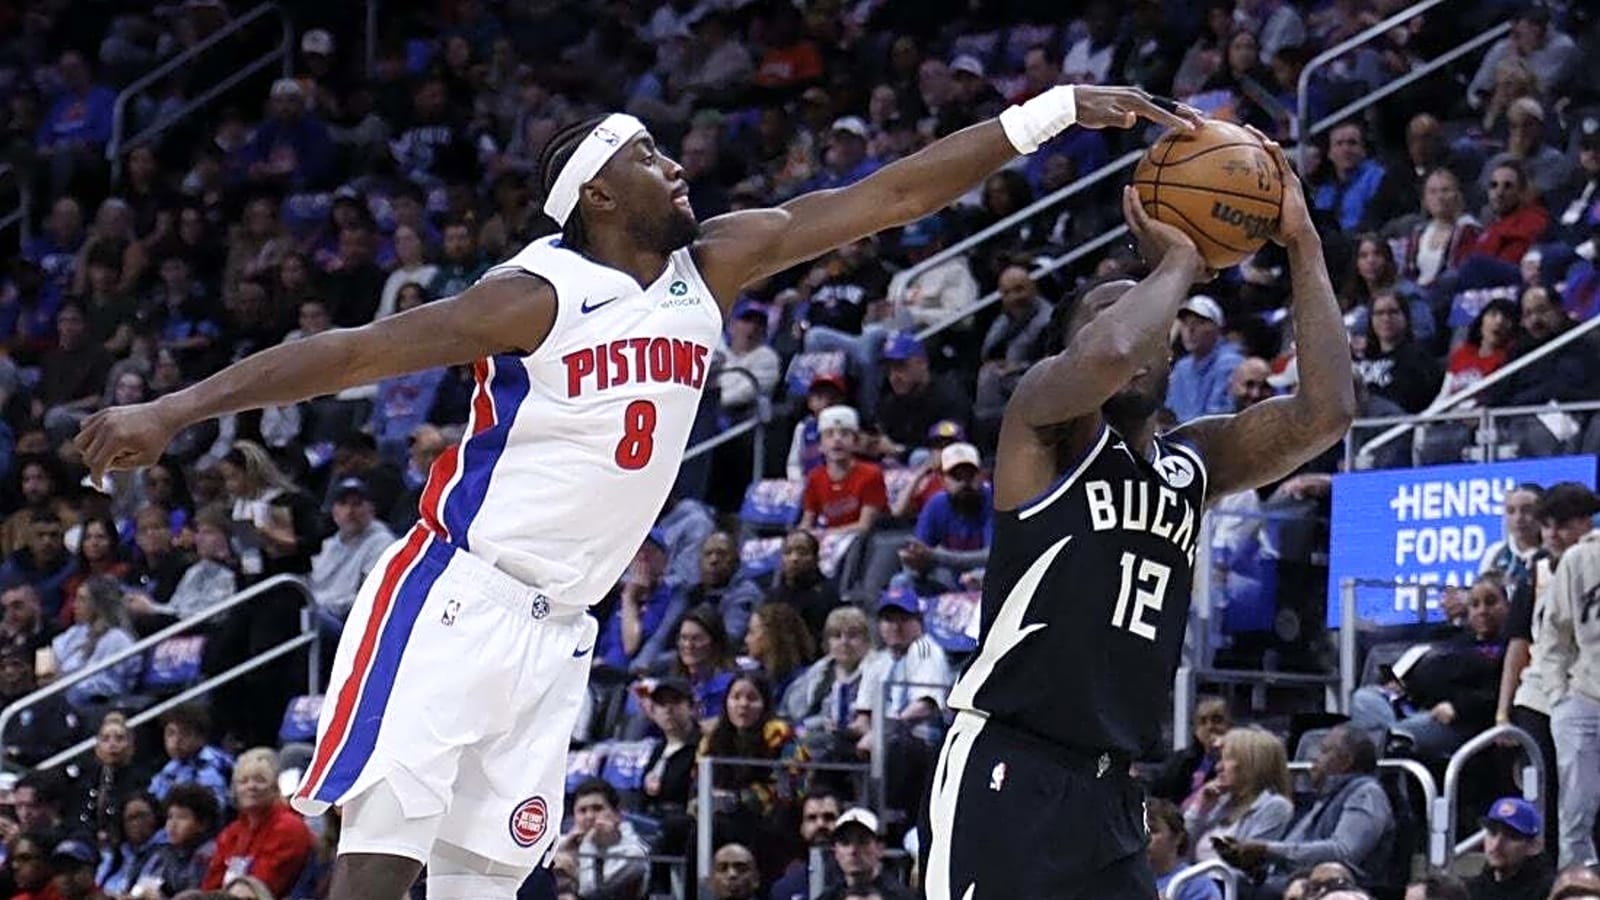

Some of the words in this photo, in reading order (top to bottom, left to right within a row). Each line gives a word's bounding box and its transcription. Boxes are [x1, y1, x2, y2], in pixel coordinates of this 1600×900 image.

[561, 337, 708, 398] PISTONS
[615, 400, 656, 470] 8
[1390, 477, 1515, 521] HENRY
[1395, 525, 1486, 566] FORD
[1112, 552, 1171, 640] 12
